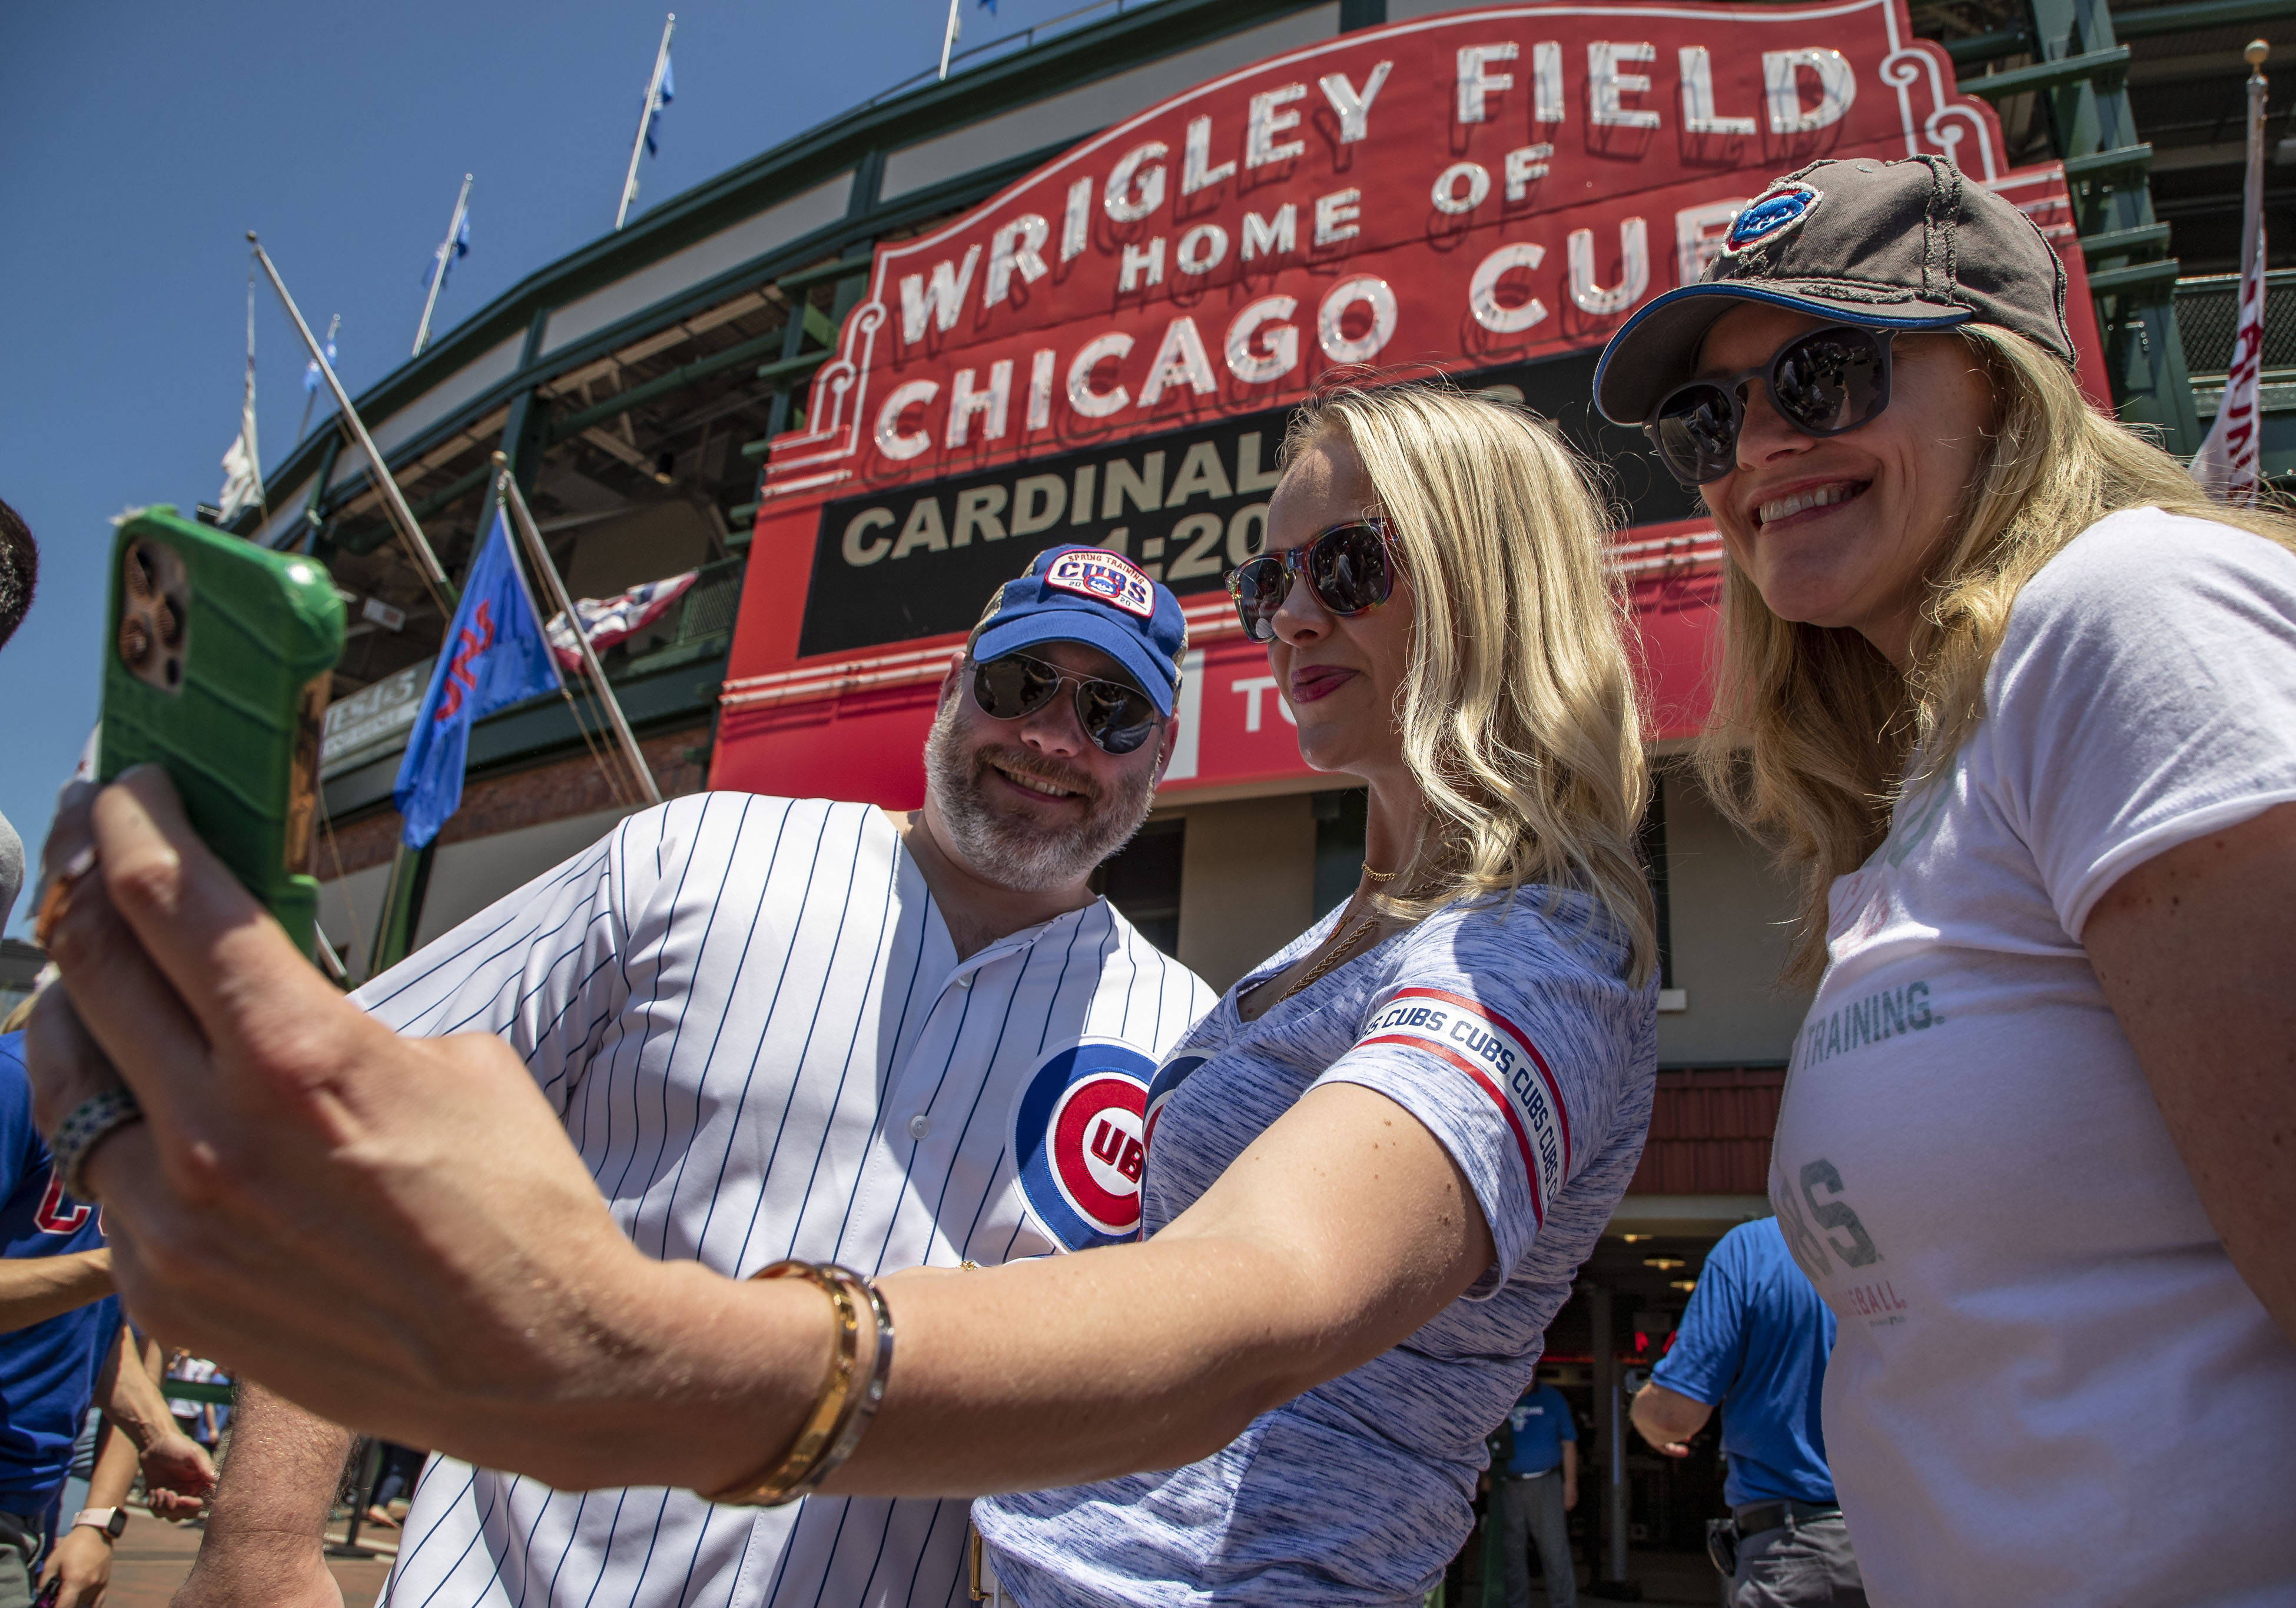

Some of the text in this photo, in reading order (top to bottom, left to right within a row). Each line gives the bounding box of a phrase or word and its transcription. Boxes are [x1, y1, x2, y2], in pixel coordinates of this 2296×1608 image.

[899, 40, 1856, 344] WRIGLEY FIELD
[1119, 142, 1554, 293] HOME OF
[874, 274, 1398, 461] CHICAGO
[842, 430, 1284, 566] CARDINAL
[1069, 553, 1102, 562] SPRING
[1057, 562, 1146, 604] CUBS
[1106, 556, 1144, 585] TRAINING
[1120, 596, 1131, 607] 20
[1381, 1007, 1448, 1031] CUBS
[1449, 1020, 1515, 1075] CUBS
[1512, 1067, 1549, 1132] CUBS
[1539, 1125, 1558, 1185] CUBS
